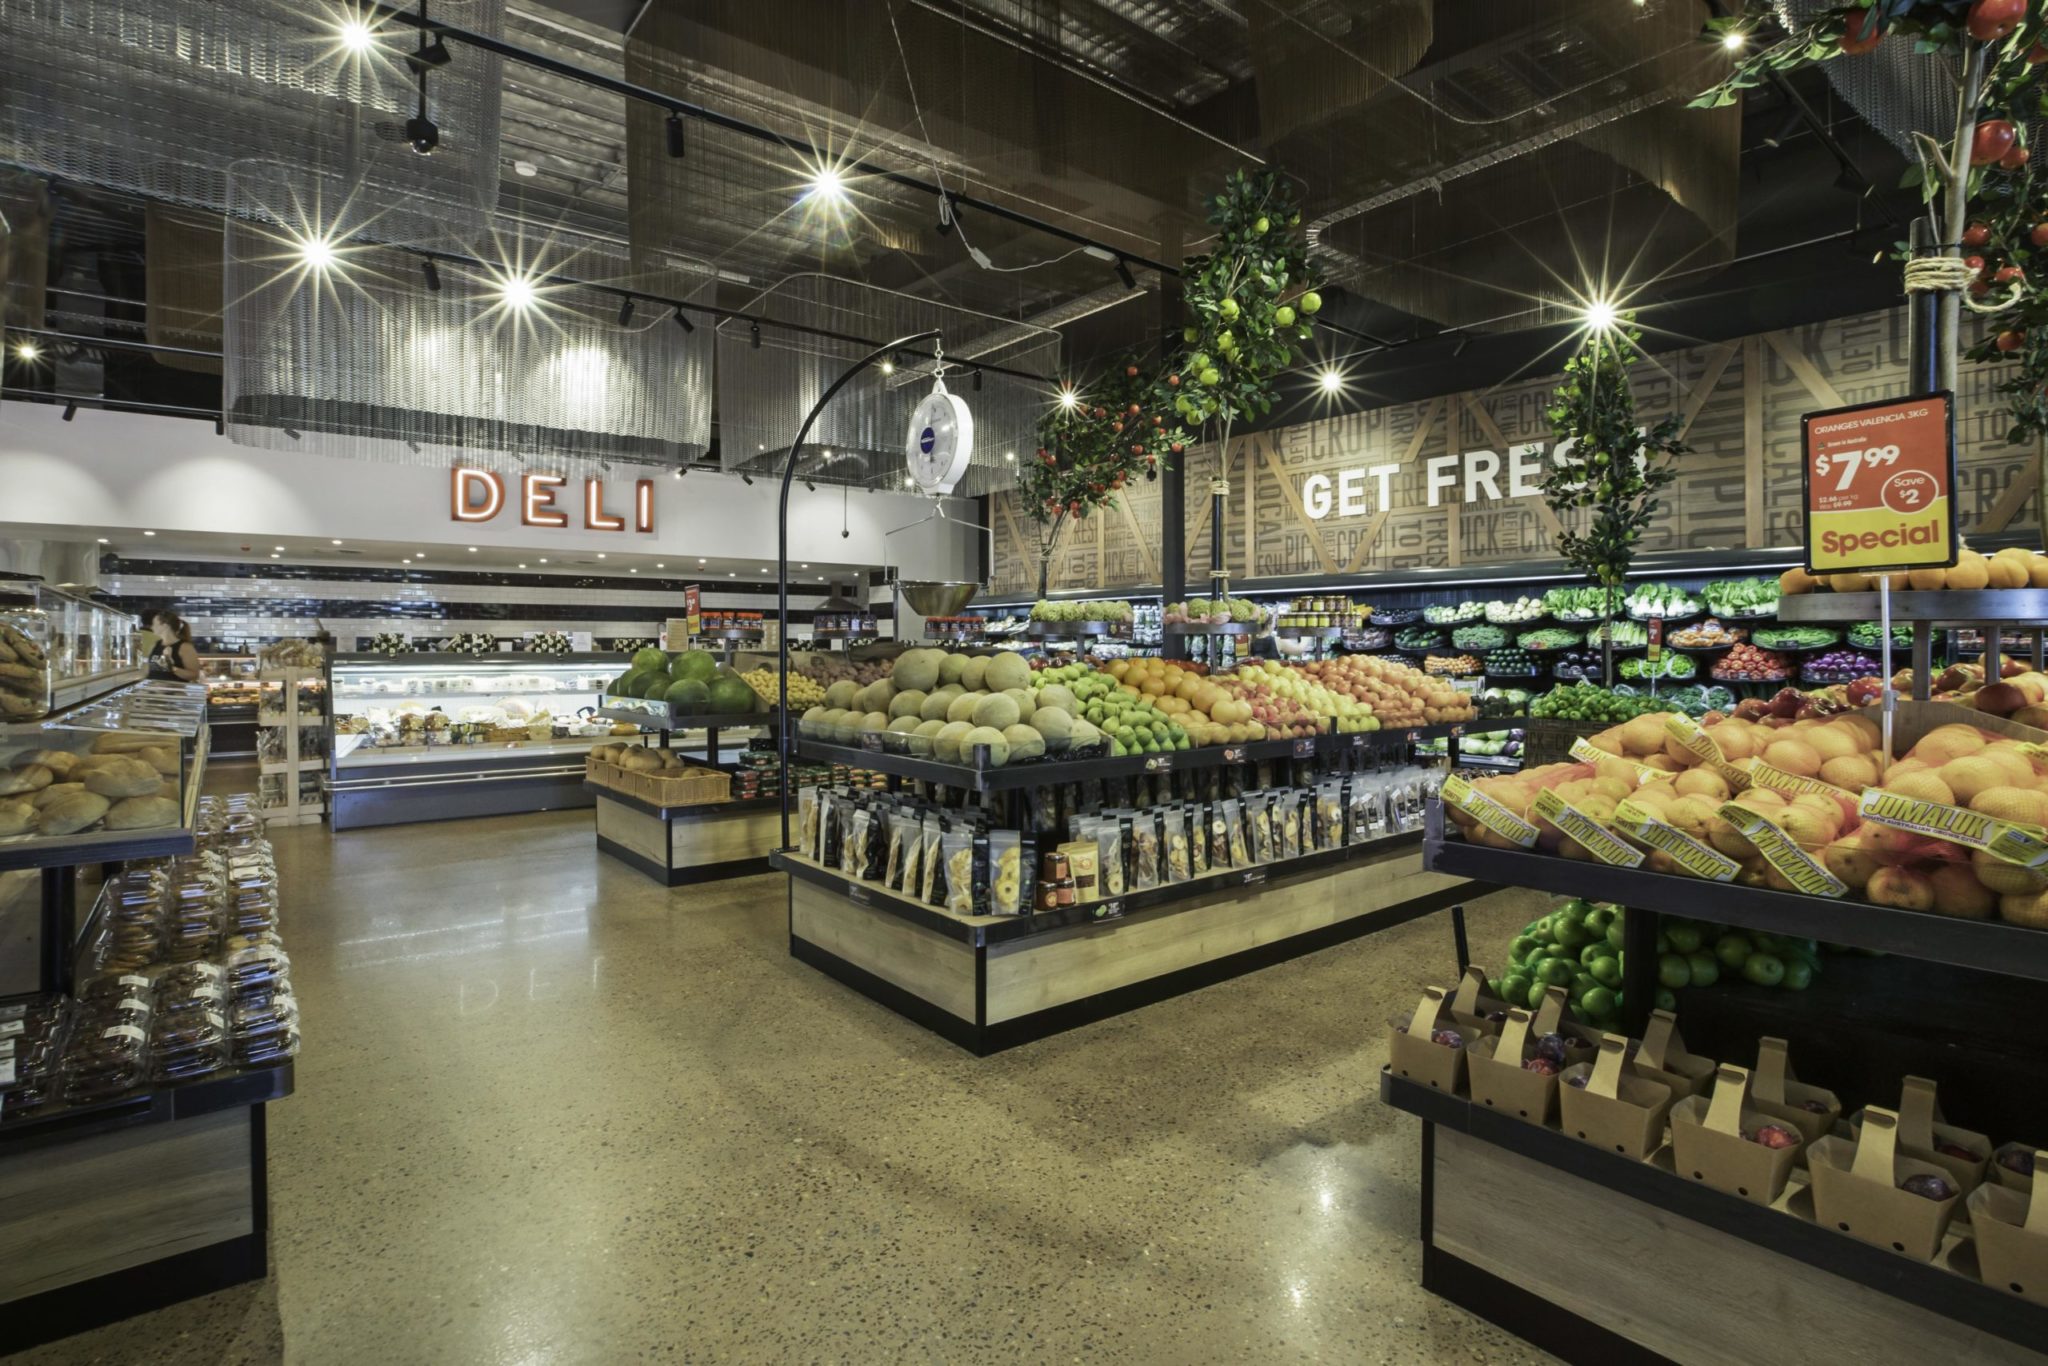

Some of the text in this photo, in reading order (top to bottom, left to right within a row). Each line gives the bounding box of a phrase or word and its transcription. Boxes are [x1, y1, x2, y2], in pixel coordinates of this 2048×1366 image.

[1814, 408, 1928, 435] ORANGES VALENCIA 3KG
[1303, 463, 1400, 520] GET
[1428, 426, 1647, 507] FRES
[1894, 476, 1925, 487] Save
[1900, 488, 1919, 504] $2
[451, 466, 653, 533] DELI
[1821, 519, 1940, 557] Special
[1557, 813, 1638, 866] JUMALUK
[1864, 794, 1992, 840] JUMALUK
[1639, 824, 1733, 880] JUMALUK
[1746, 825, 1837, 895] JUMALUK
